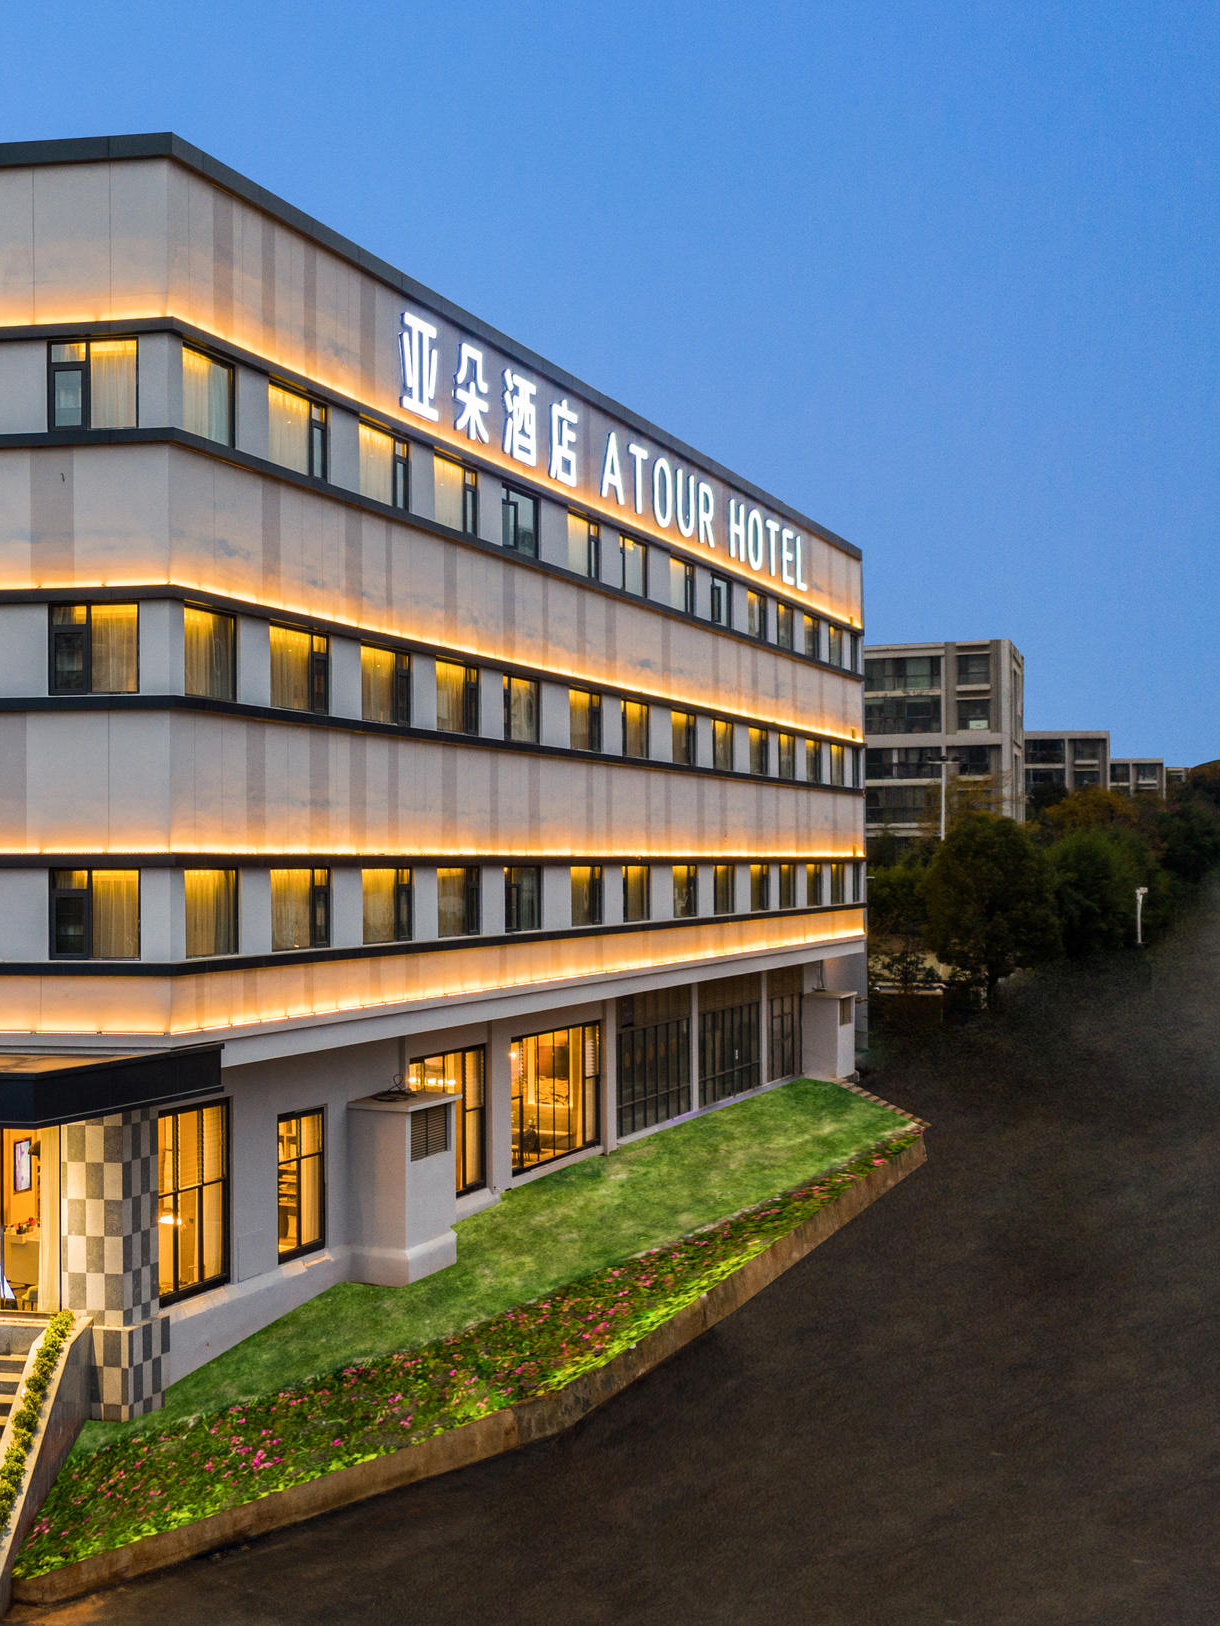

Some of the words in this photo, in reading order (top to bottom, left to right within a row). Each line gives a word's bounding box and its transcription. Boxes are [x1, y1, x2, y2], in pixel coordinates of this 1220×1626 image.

[399, 312, 578, 488] 亚朵酒店
[600, 432, 716, 549] ATOUR
[728, 497, 808, 593] HOTEL
